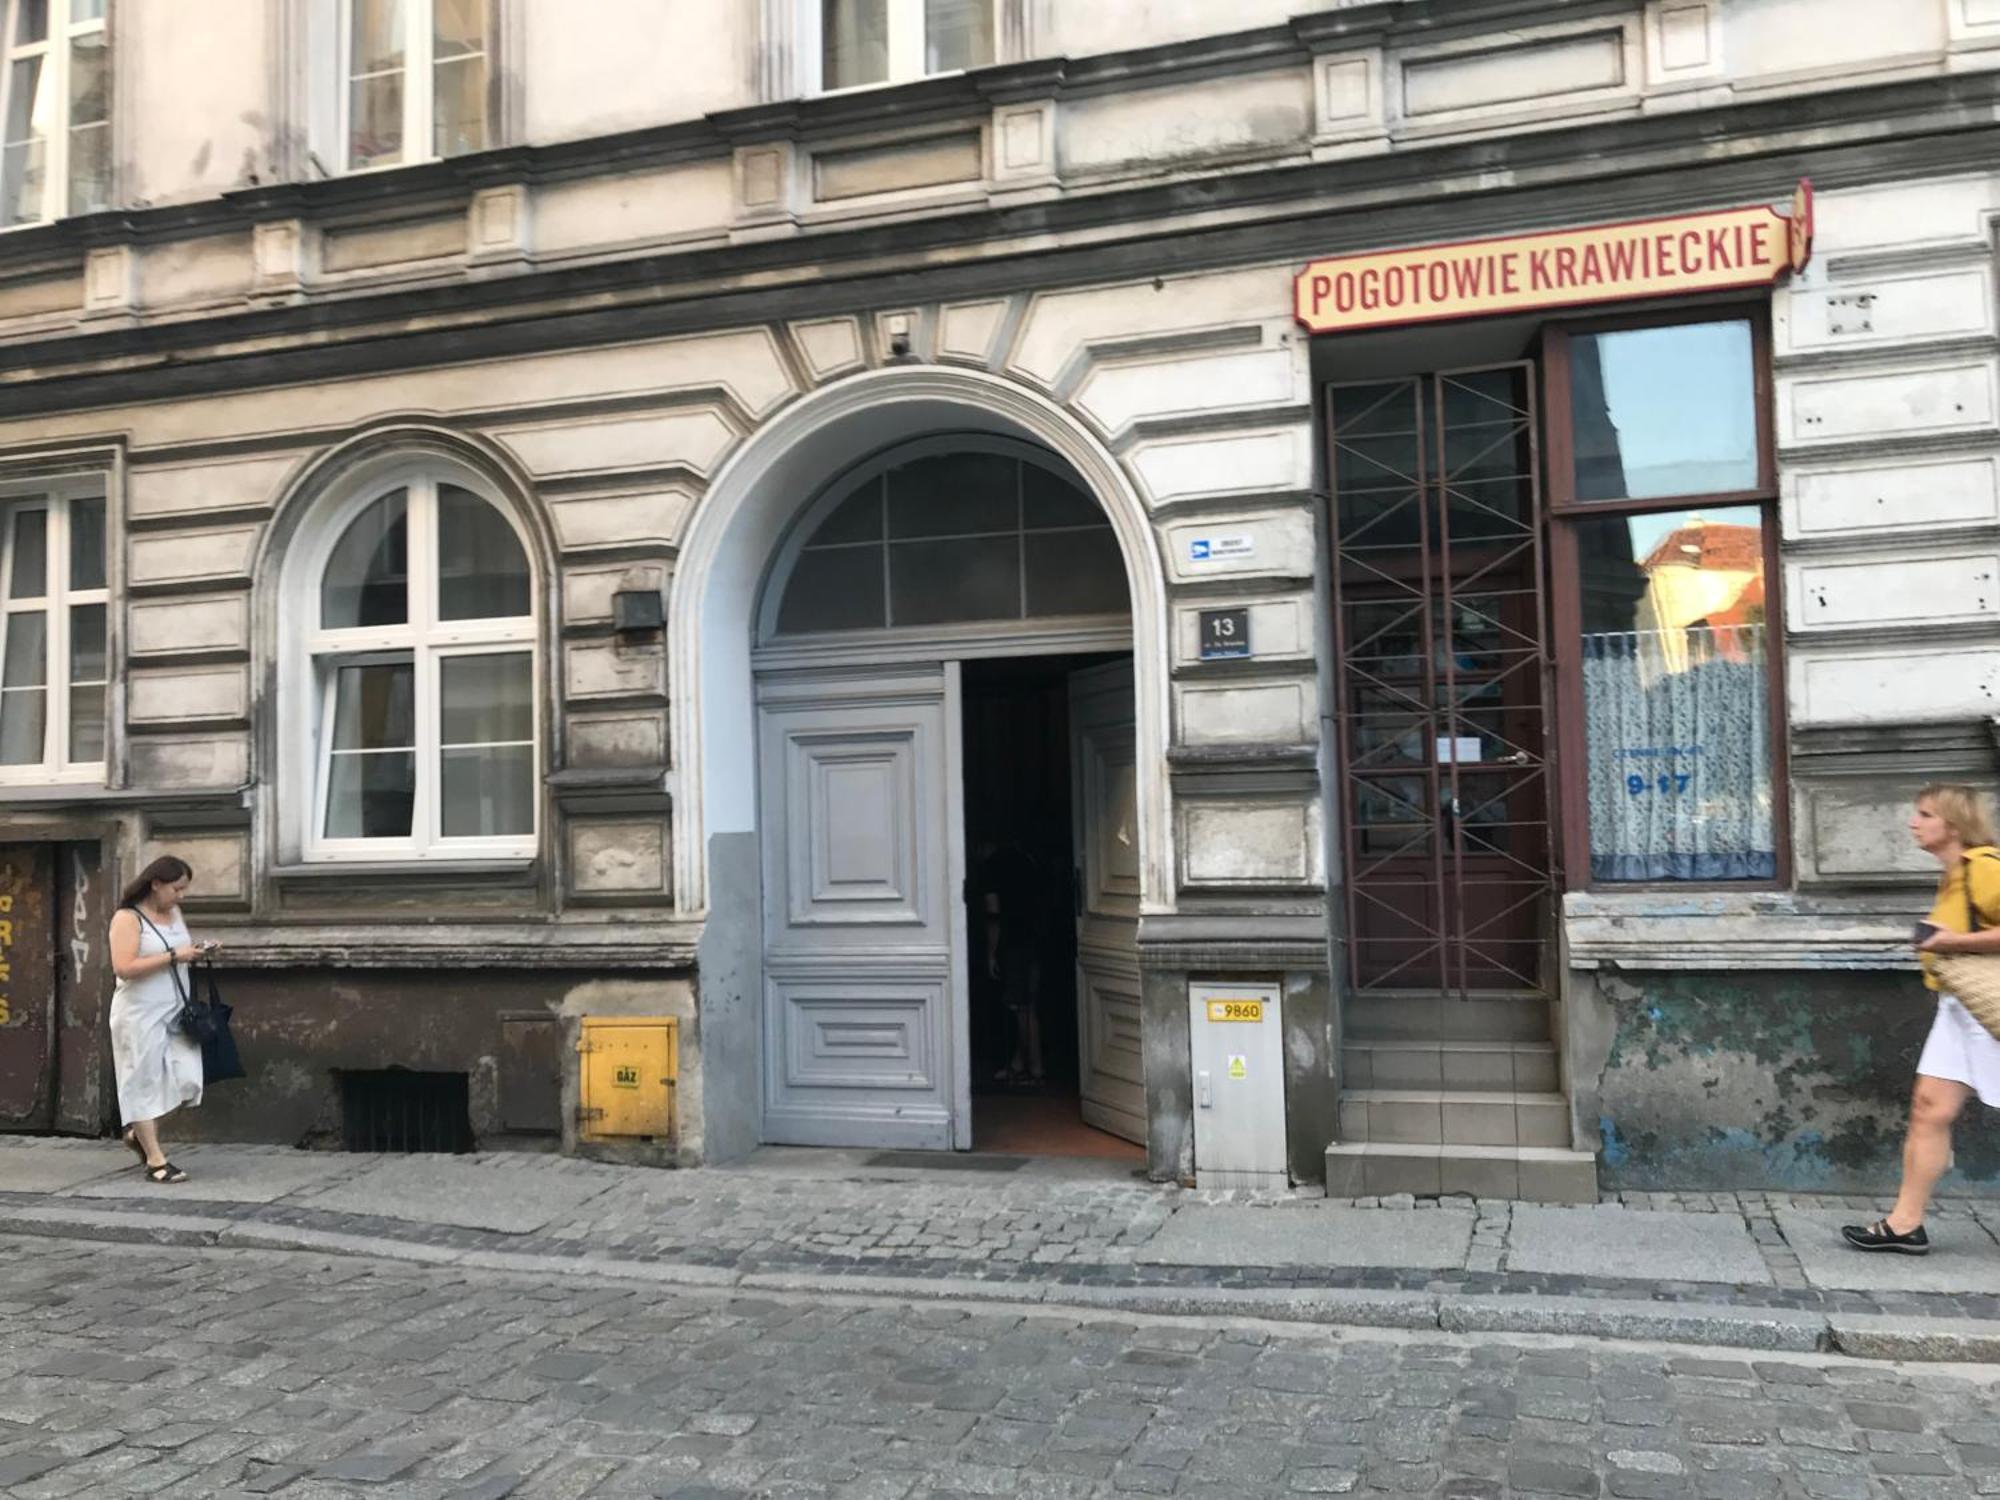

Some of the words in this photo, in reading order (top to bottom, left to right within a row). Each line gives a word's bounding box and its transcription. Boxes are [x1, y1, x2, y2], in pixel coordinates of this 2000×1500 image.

[1311, 252, 1520, 316] POGOTOWIE
[1529, 222, 1771, 292] KRAWIECKIE
[1212, 617, 1235, 636] 13
[1224, 1004, 1260, 1018] 9860
[616, 1070, 637, 1083] GAZ
